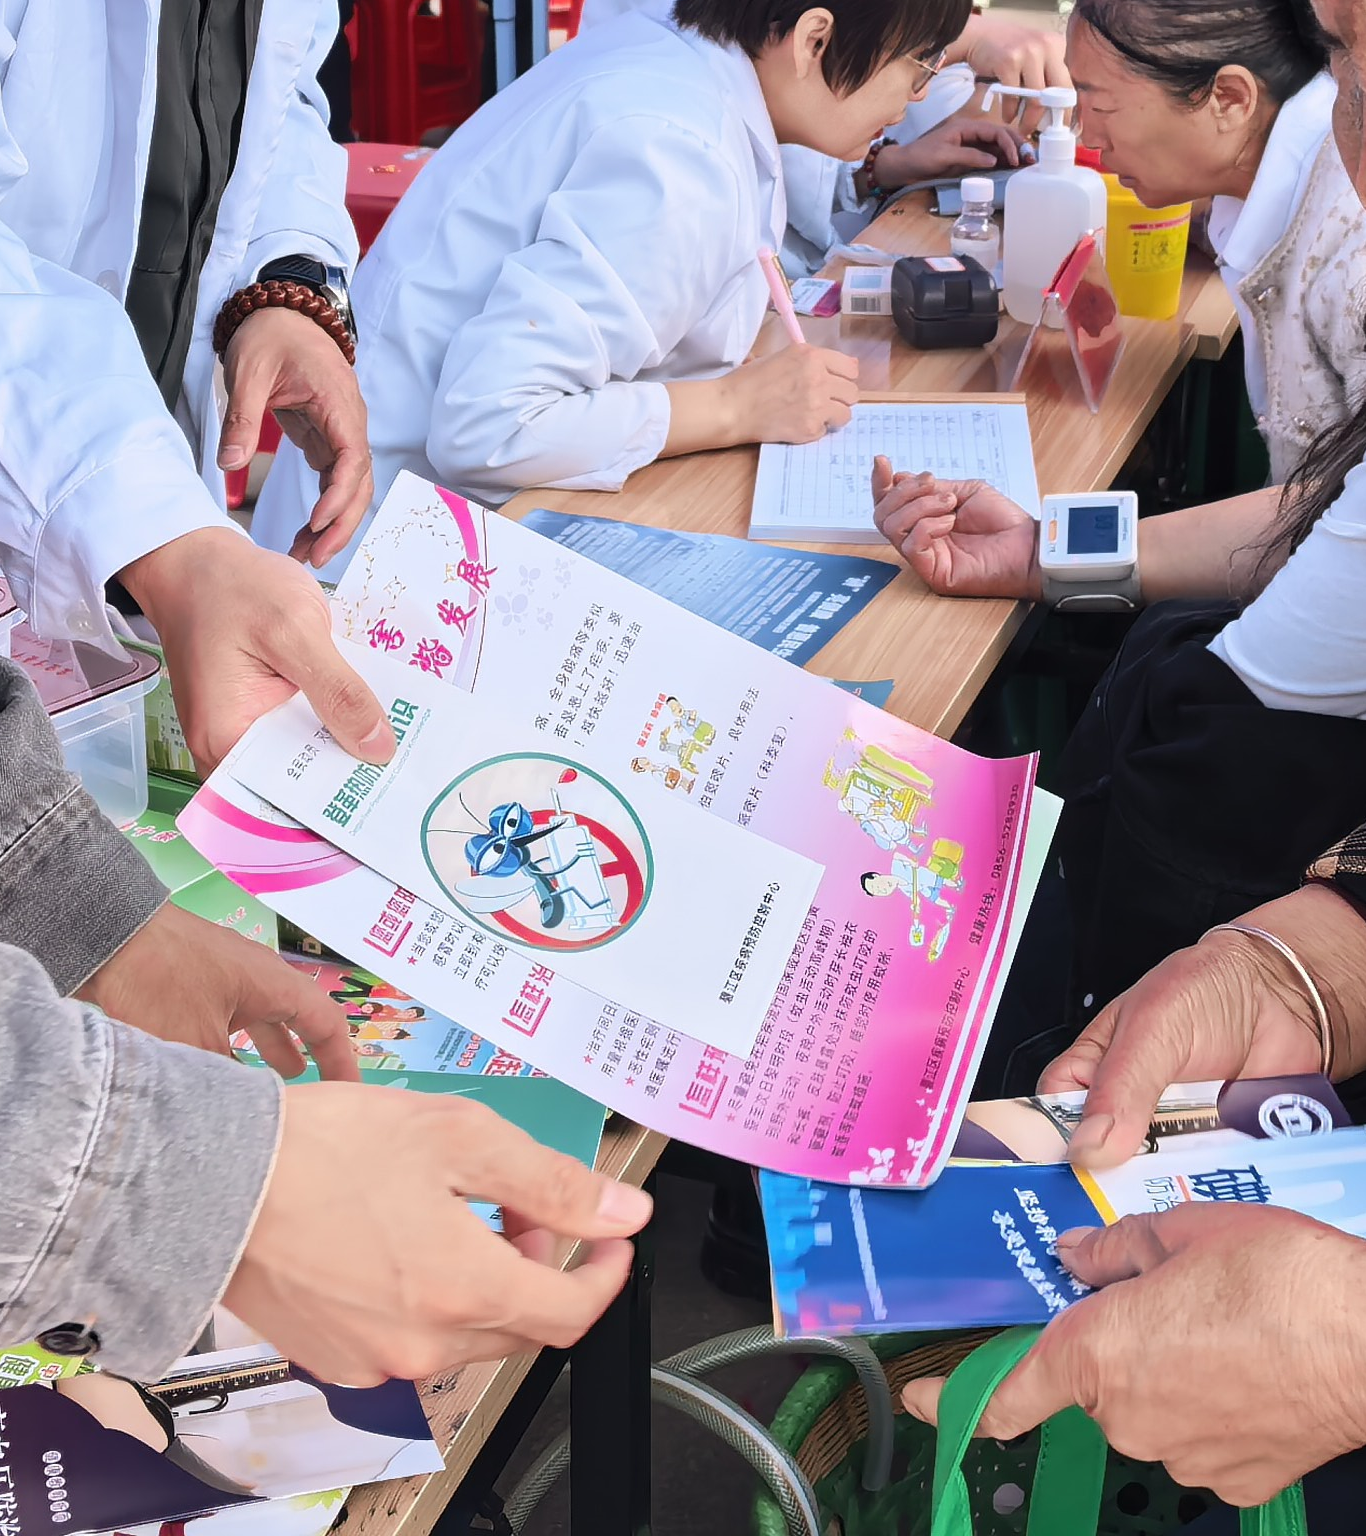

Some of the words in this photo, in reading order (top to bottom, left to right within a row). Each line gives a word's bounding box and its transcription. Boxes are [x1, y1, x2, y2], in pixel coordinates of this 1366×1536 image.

[362, 613, 410, 661] 害
[321, 695, 419, 828] 登革热防识
[584, 999, 620, 1055] 治疗间日
[600, 1009, 641, 1078] 用量根据医
[643, 1028, 684, 1098] 遵医嘱进行
